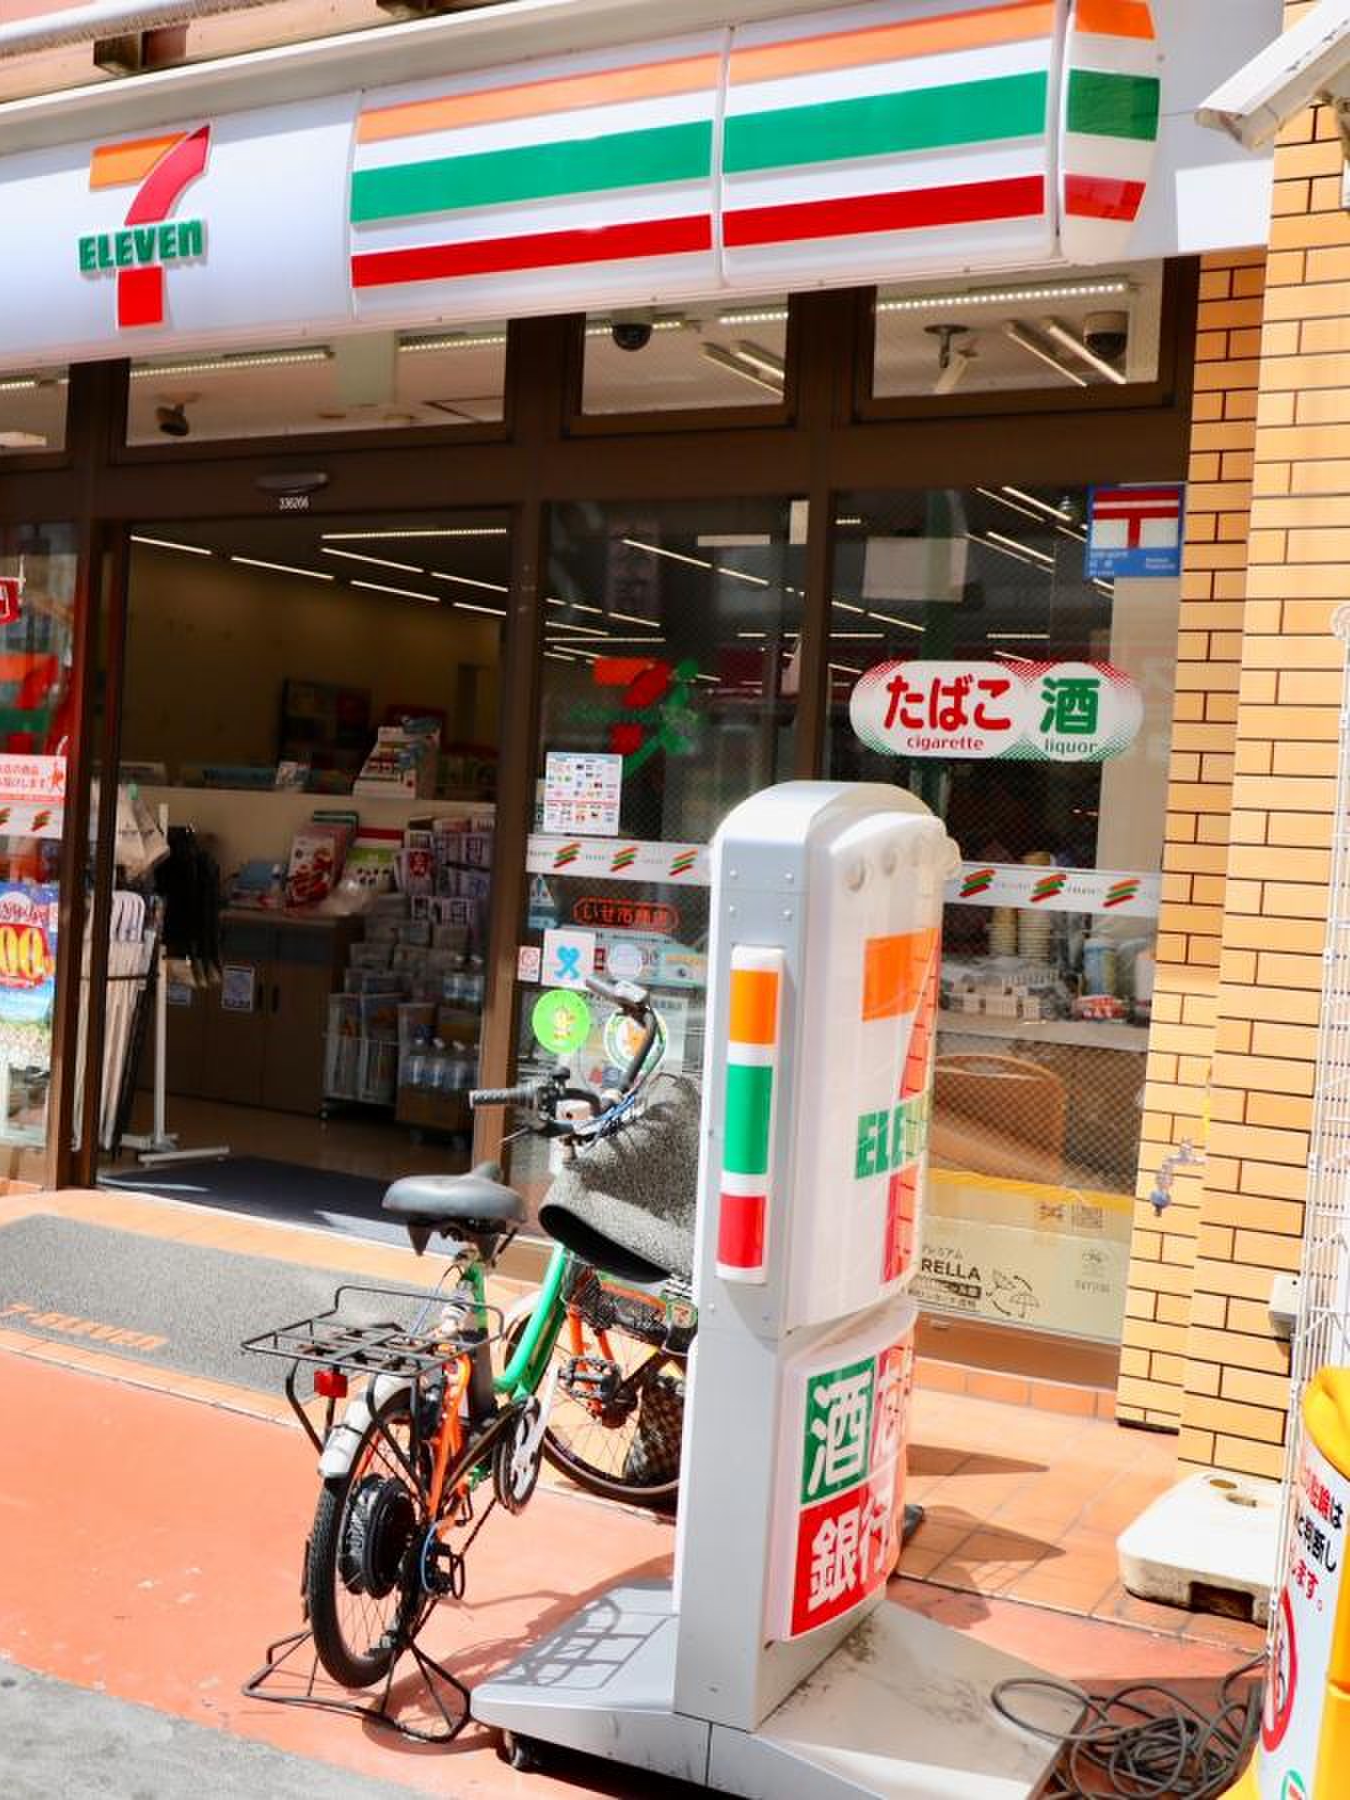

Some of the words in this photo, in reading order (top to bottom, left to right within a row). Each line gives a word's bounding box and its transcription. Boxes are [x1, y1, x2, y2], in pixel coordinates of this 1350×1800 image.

[884, 674, 1011, 731] たばこ
[1040, 676, 1100, 734] 酒
[906, 736, 984, 753] cigarette
[1045, 737, 1098, 754] liquor
[808, 1368, 872, 1496] 酒
